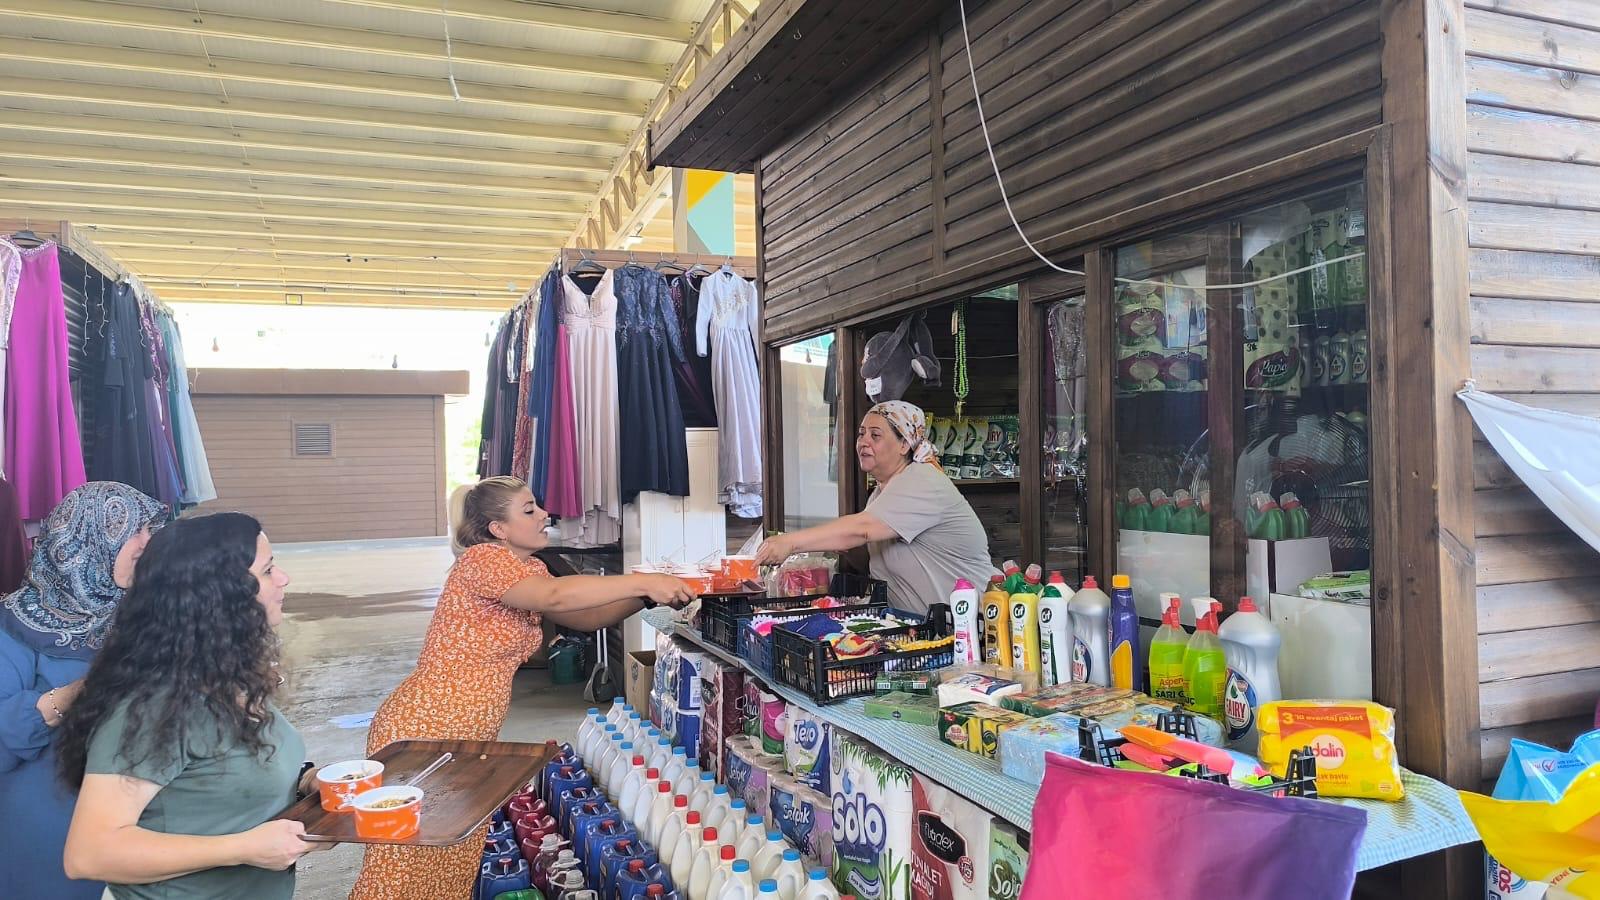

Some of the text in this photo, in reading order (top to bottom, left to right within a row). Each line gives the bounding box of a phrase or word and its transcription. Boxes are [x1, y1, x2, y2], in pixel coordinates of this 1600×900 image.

[956, 601, 969, 613] Cif
[986, 605, 998, 618] Cif
[1013, 604, 1025, 617] Cif
[1041, 609, 1052, 622] Cif
[1156, 690, 1176, 698] SARI
[1282, 712, 1294, 725] 3
[1312, 742, 1344, 758] dalin
[832, 792, 886, 852] Solo
